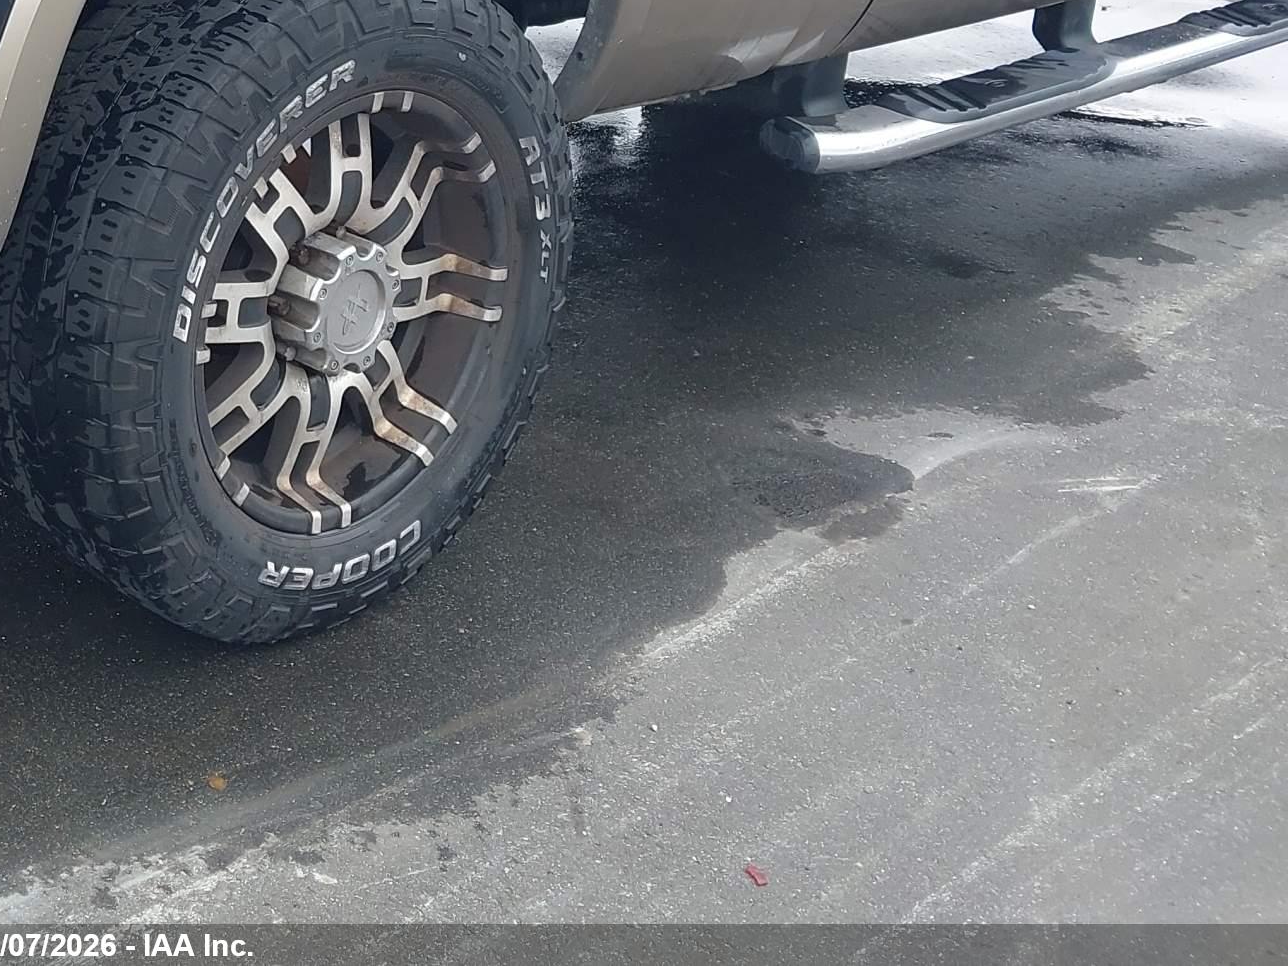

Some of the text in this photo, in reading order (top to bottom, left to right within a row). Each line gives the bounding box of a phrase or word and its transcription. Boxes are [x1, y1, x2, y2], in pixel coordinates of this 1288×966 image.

[172, 59, 357, 343] DISCOVERER
[518, 135, 553, 221] AT3
[258, 519, 422, 591] COOPER
